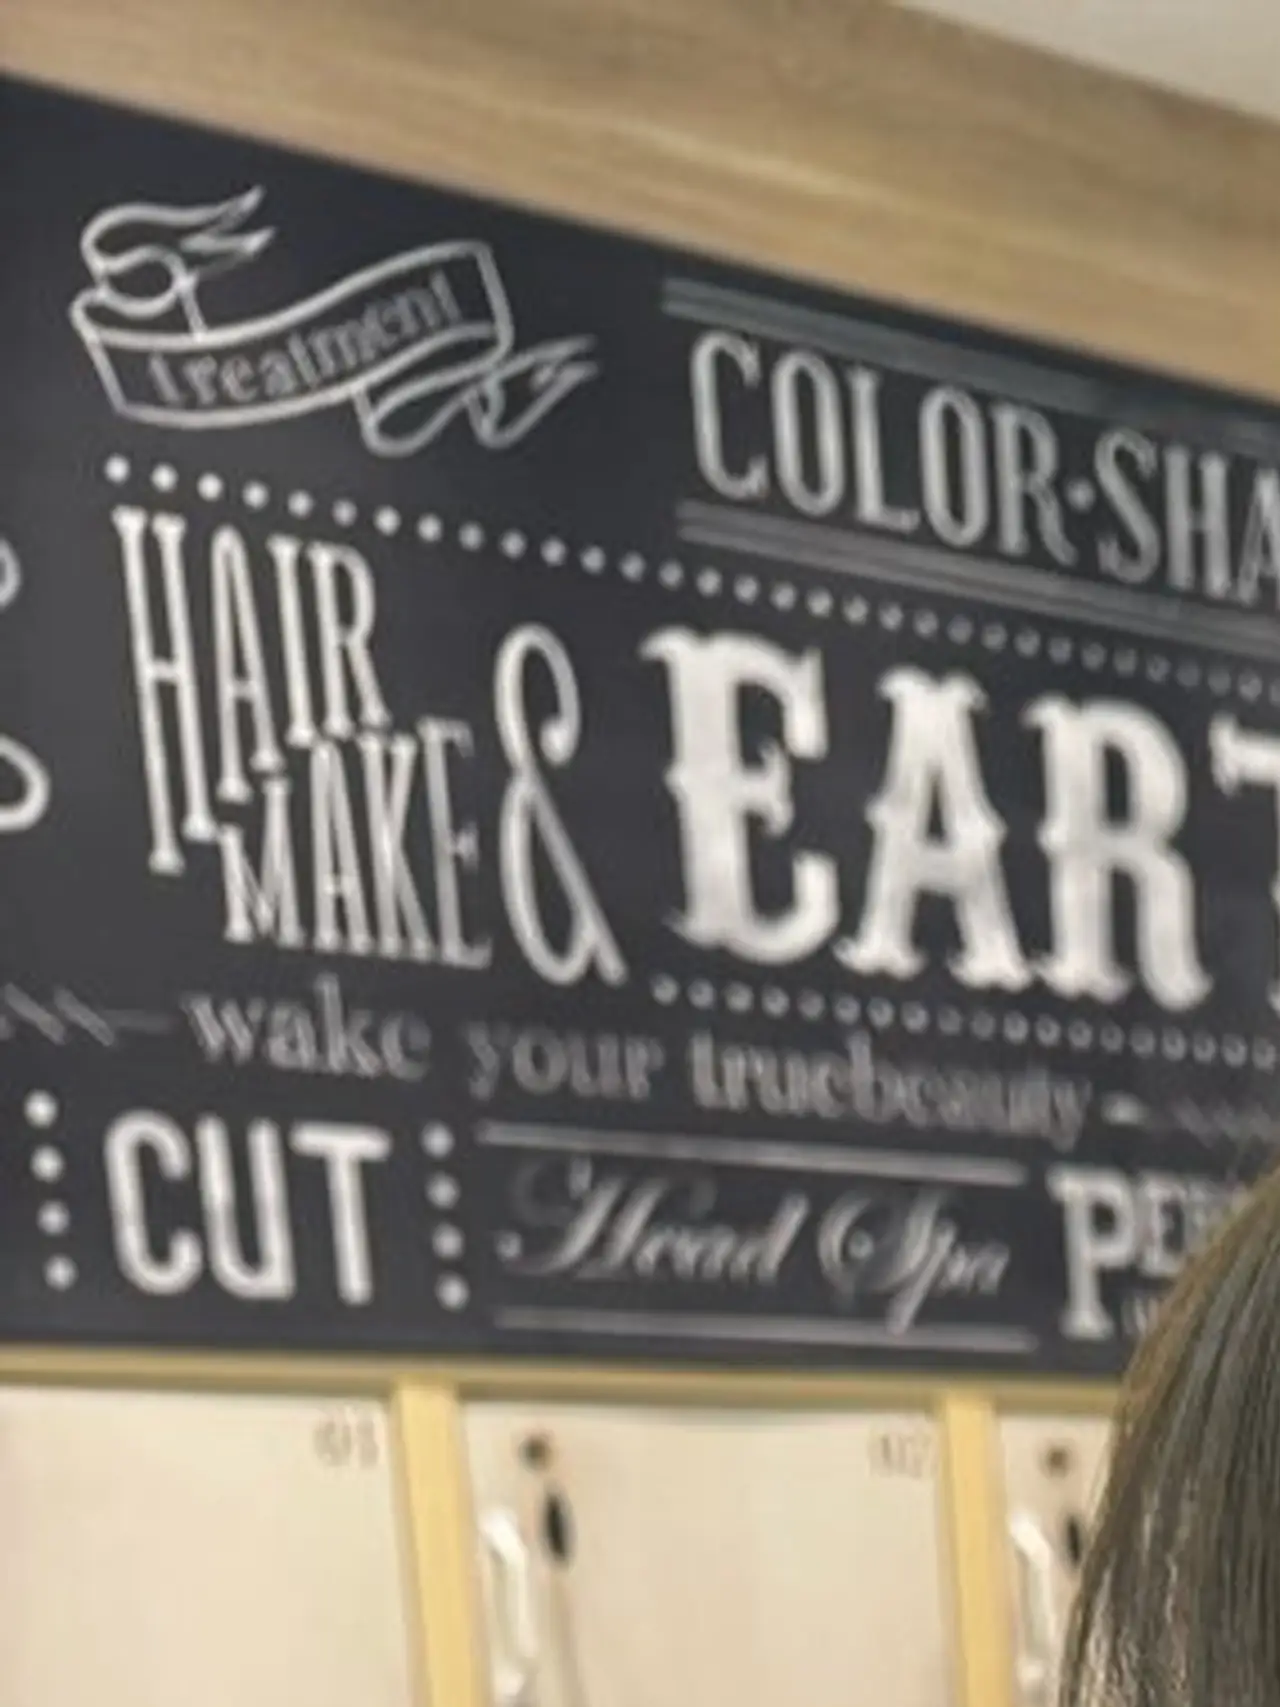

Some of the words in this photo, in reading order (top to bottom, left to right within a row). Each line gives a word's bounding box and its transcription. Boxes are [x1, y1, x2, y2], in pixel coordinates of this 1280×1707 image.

[148, 271, 464, 406] treatment
[112, 503, 390, 874] HAIR
[218, 716, 492, 970] MAKE
[494, 624, 628, 986] &
[184, 974, 431, 1080] wake
[467, 1018, 663, 1101] your
[104, 1109, 392, 1305] CUT
[497, 1157, 809, 1280] Head
[817, 1188, 1010, 1337] Spa
